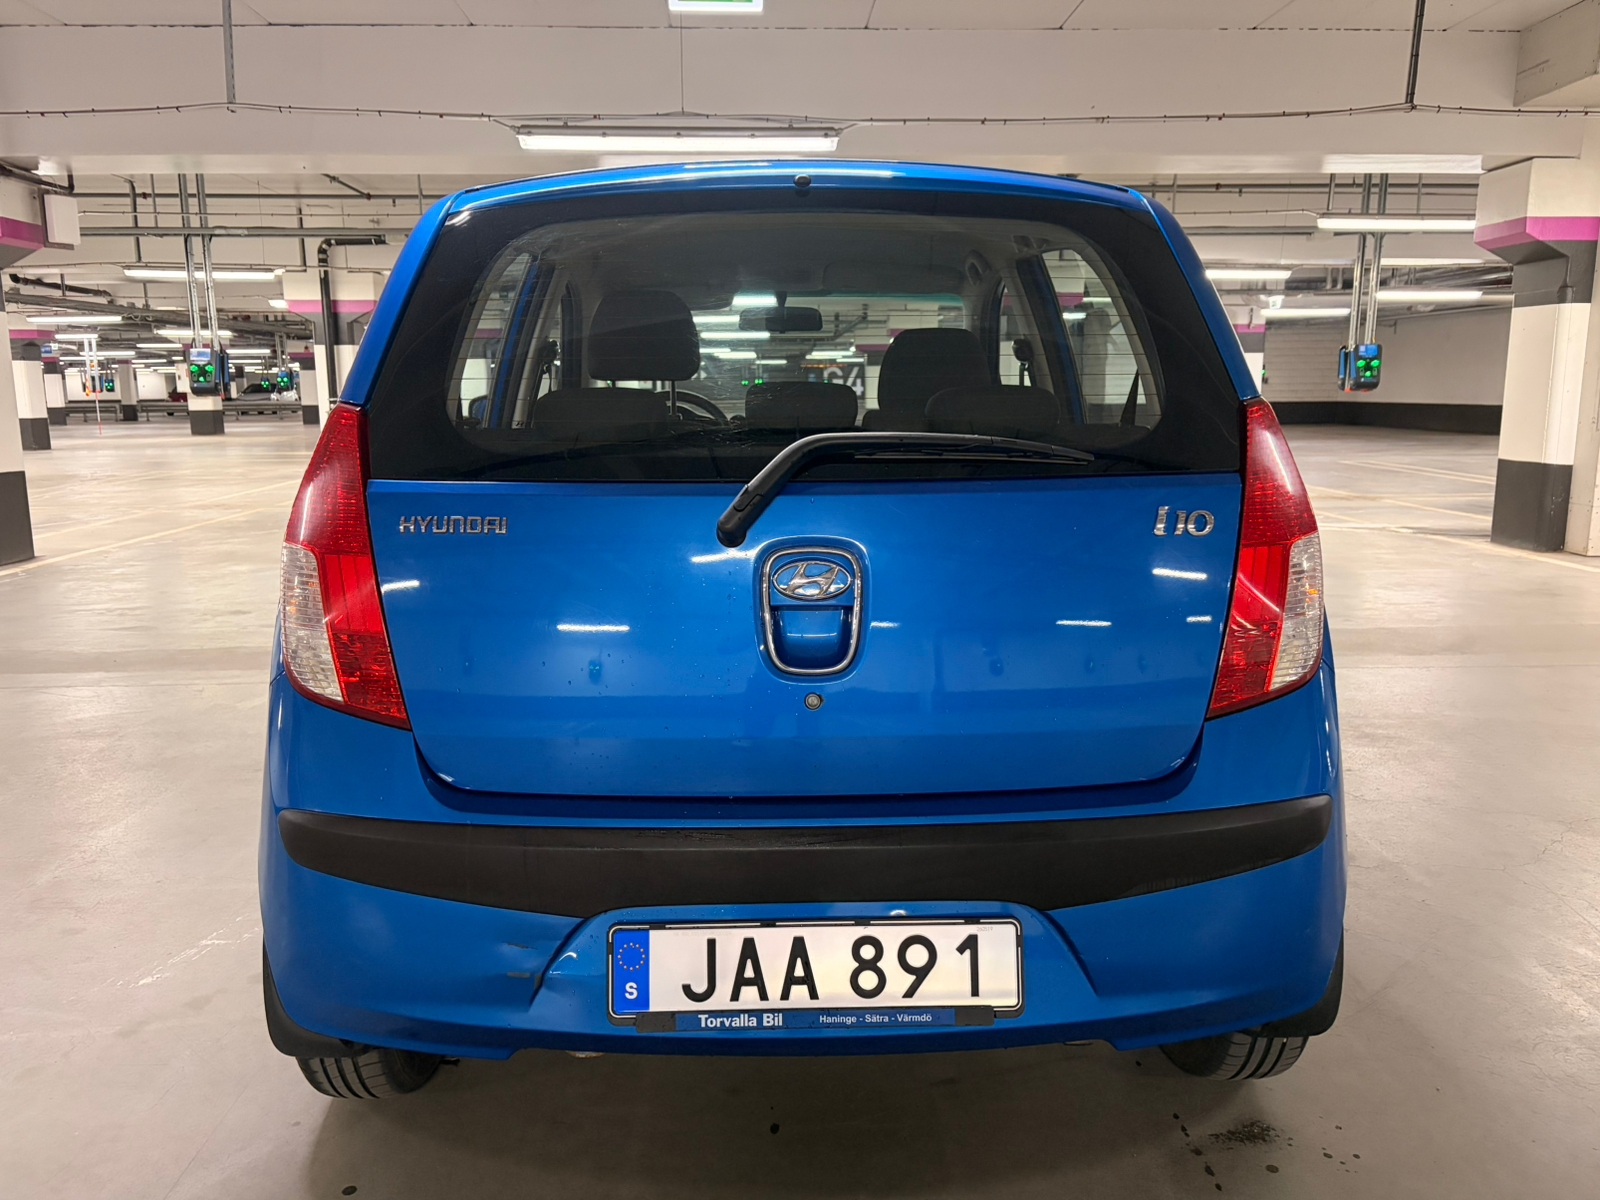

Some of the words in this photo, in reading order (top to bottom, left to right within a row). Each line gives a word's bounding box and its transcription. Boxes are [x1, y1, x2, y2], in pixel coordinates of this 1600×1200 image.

[399, 515, 507, 534] HYUNDAI
[681, 936, 820, 1003] JAA
[849, 933, 980, 1000] 891
[624, 981, 639, 1000] S
[698, 1013, 757, 1028] Torvalla
[762, 1012, 783, 1027] Bil
[819, 1014, 857, 1025] Haninge
[865, 1014, 889, 1023] Sätra
[896, 1013, 933, 1023] Värmdö
